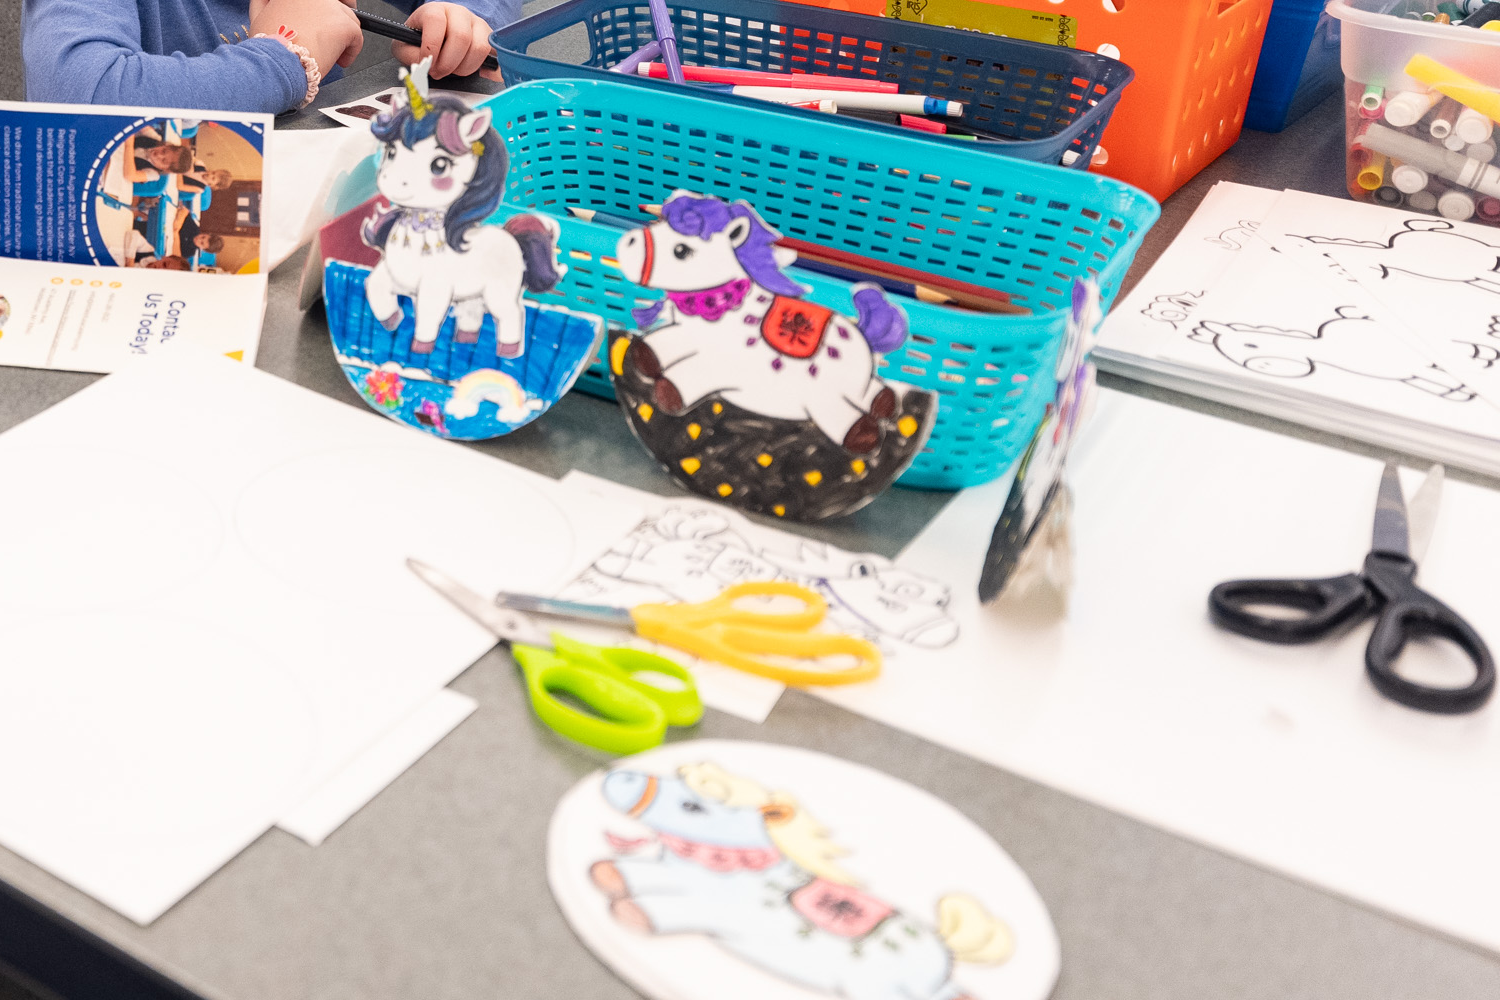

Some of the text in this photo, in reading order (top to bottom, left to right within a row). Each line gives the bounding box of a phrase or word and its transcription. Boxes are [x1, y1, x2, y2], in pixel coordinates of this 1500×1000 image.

[906, 0, 921, 10] IRIS
[15, 127, 22, 140] We
[57, 128, 66, 164] Religious
[68, 129, 76, 165] Founded
[35, 152, 43, 203] development
[67, 175, 76, 202] August
[46, 178, 54, 215] academic
[57, 206, 65, 225] Little
[4, 239, 11, 253] We
[46, 217, 54, 256] excellence
[57, 227, 65, 248] Lotus
[129, 293, 163, 355] Us Today!
